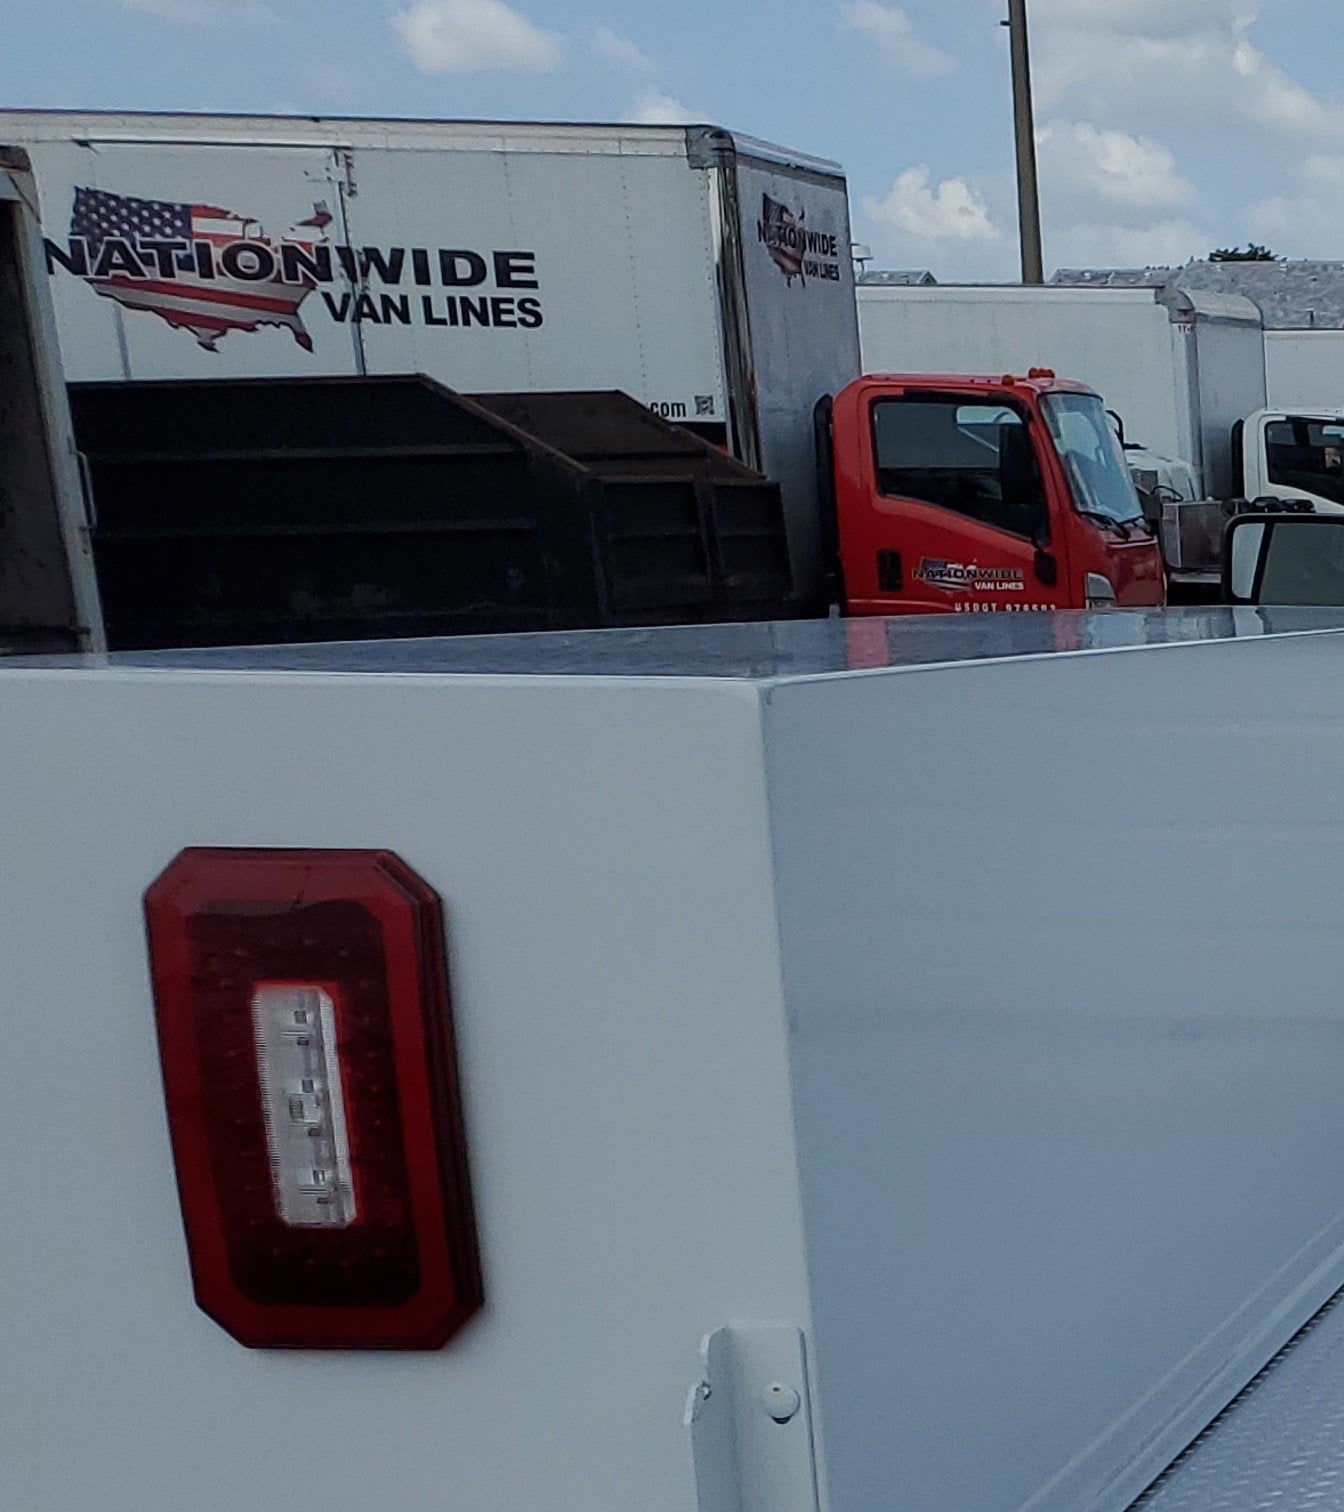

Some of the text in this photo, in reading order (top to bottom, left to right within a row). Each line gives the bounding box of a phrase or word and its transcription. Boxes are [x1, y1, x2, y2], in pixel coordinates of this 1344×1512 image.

[43, 237, 539, 289] NATIONWIDE
[321, 291, 544, 328] VAN LINES
[911, 567, 1024, 581] NATIONWIDE
[974, 581, 1025, 591] VAN LINES
[954, 602, 997, 612] USDOT
